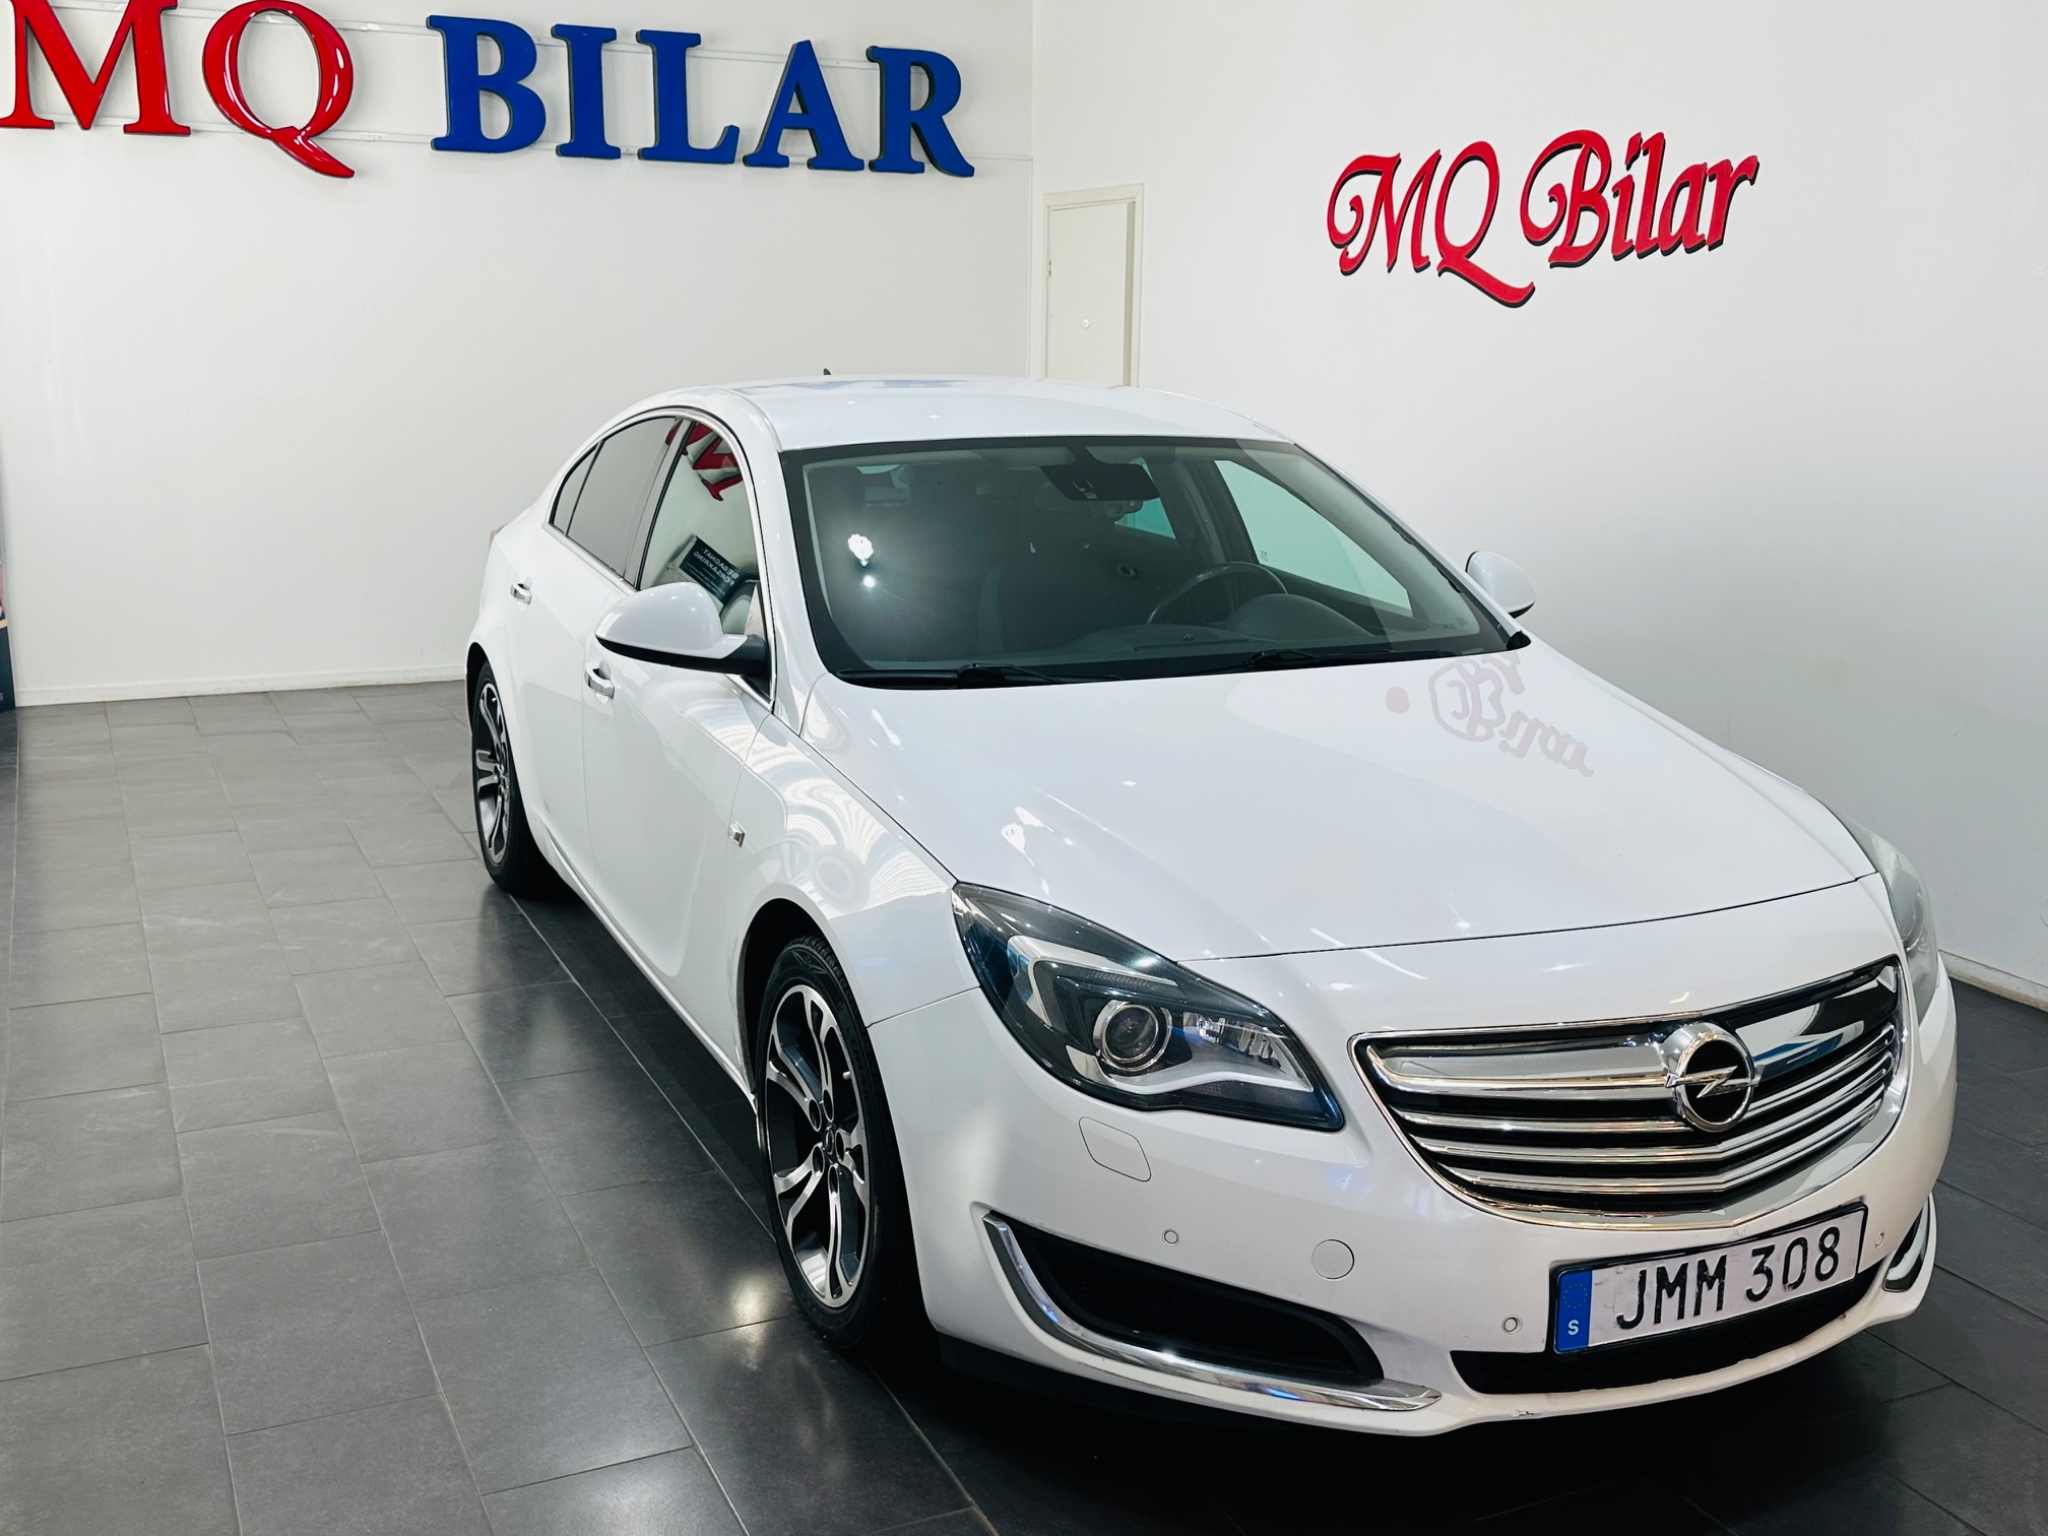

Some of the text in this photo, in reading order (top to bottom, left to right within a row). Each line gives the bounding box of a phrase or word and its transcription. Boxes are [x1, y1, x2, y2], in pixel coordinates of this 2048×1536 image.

[0, 0, 975, 178] MQ BILAR
[1326, 130, 1760, 308] MQ Bilar
[1567, 1319, 1580, 1336] S
[1616, 1226, 1842, 1331] JMM 308
